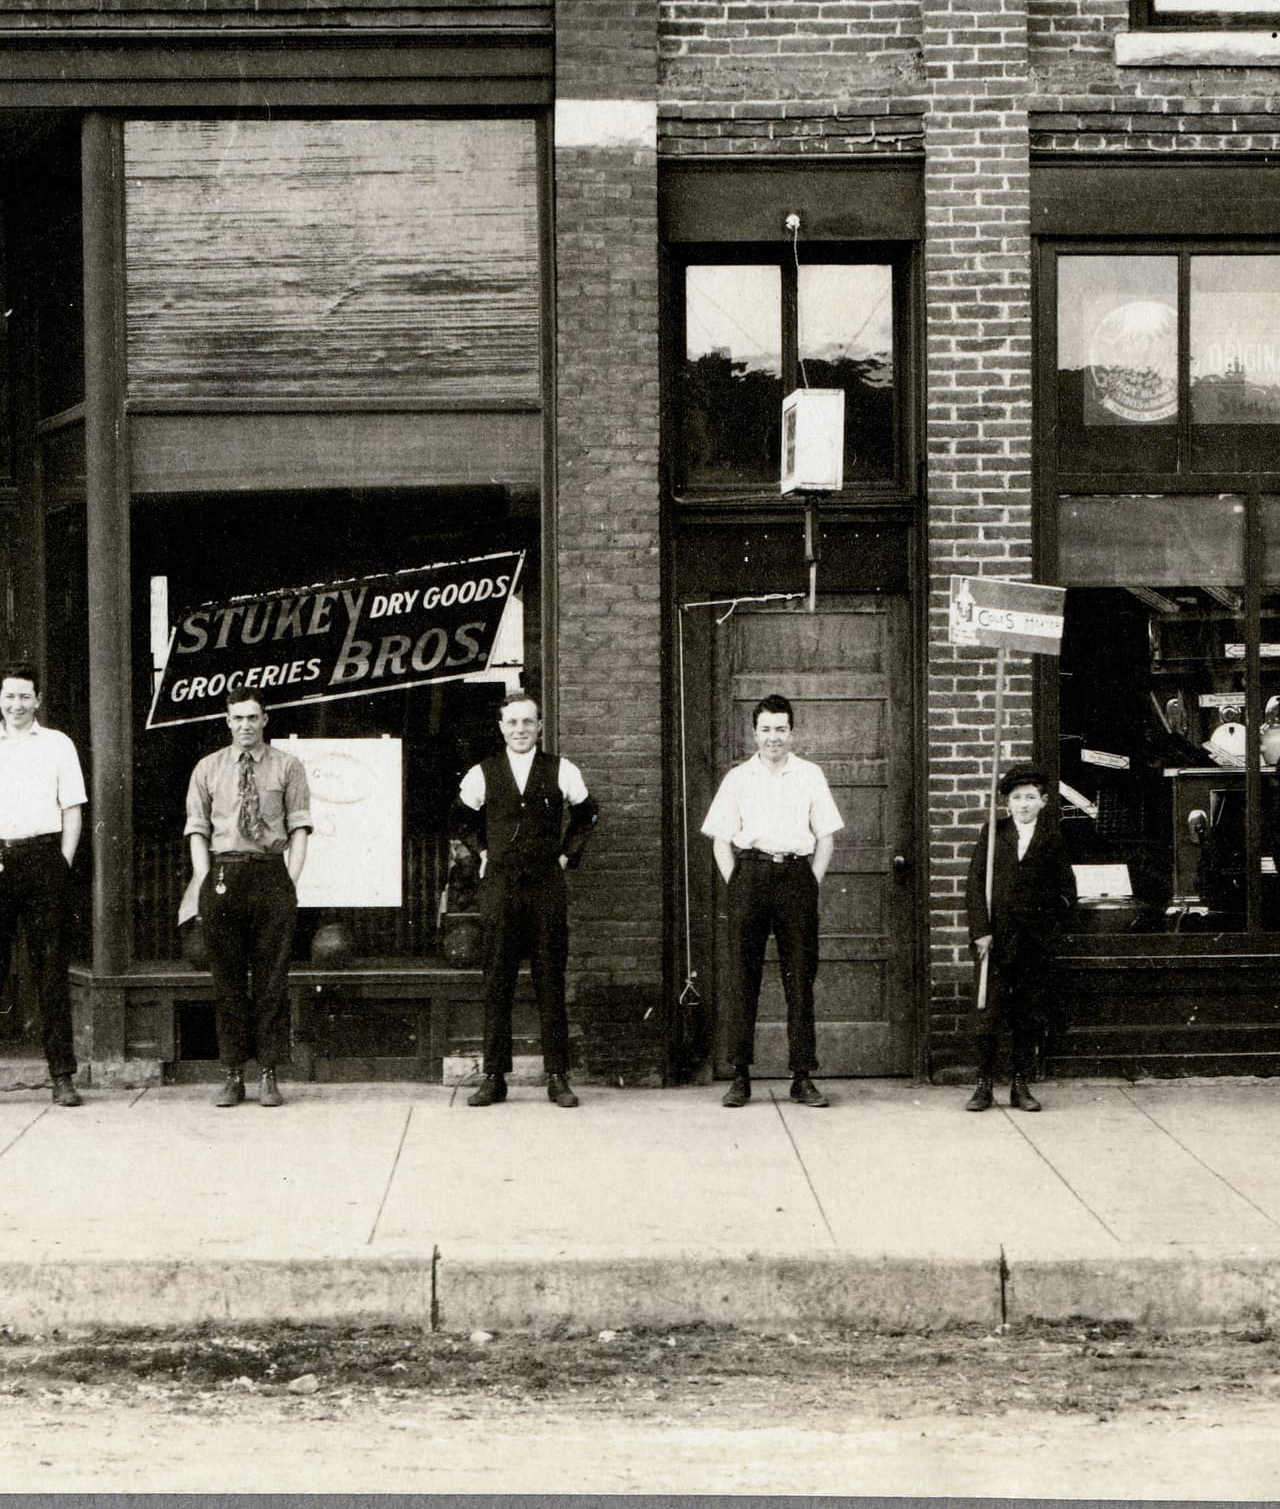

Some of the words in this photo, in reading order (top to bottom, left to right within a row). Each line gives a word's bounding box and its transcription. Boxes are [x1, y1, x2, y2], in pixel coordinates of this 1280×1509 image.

[175, 587, 370, 654] STUKEY
[369, 590, 417, 619] DRY
[423, 575, 510, 610] GOODS
[171, 658, 322, 703] GROCERIES
[327, 621, 488, 686] BROS.
